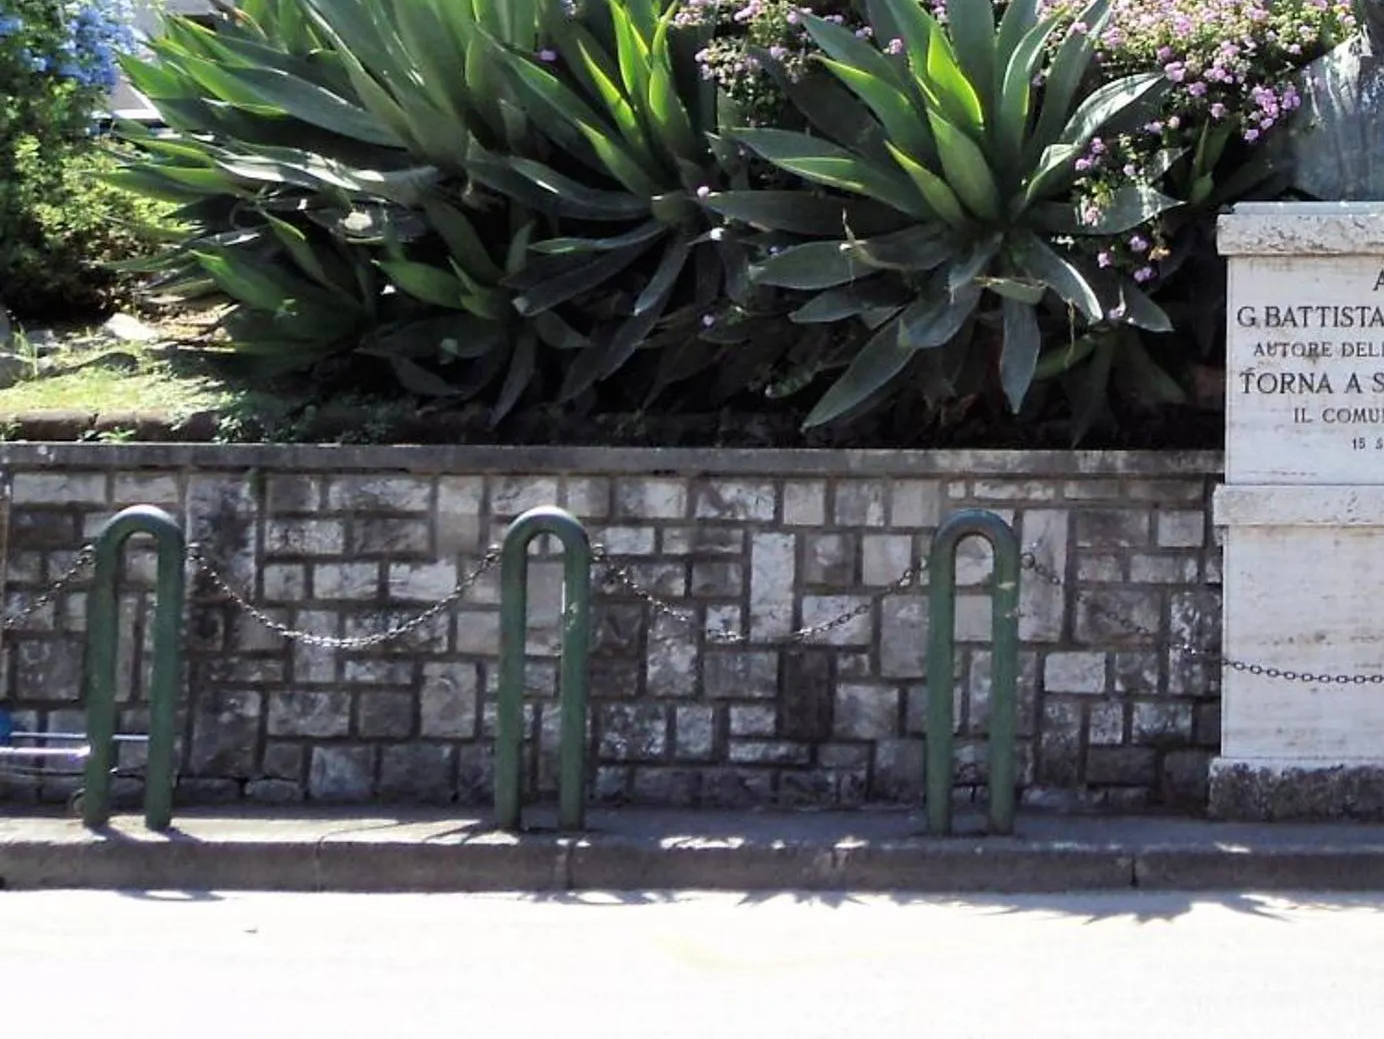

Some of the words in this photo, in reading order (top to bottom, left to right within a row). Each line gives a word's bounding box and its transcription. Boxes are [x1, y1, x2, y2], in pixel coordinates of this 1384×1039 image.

[1253, 341, 1333, 358] AUTORE
[1239, 370, 1332, 395] TORNA
[1343, 372, 1363, 395] A
[1293, 407, 1312, 424] IL
[1352, 437, 1366, 450] 15
